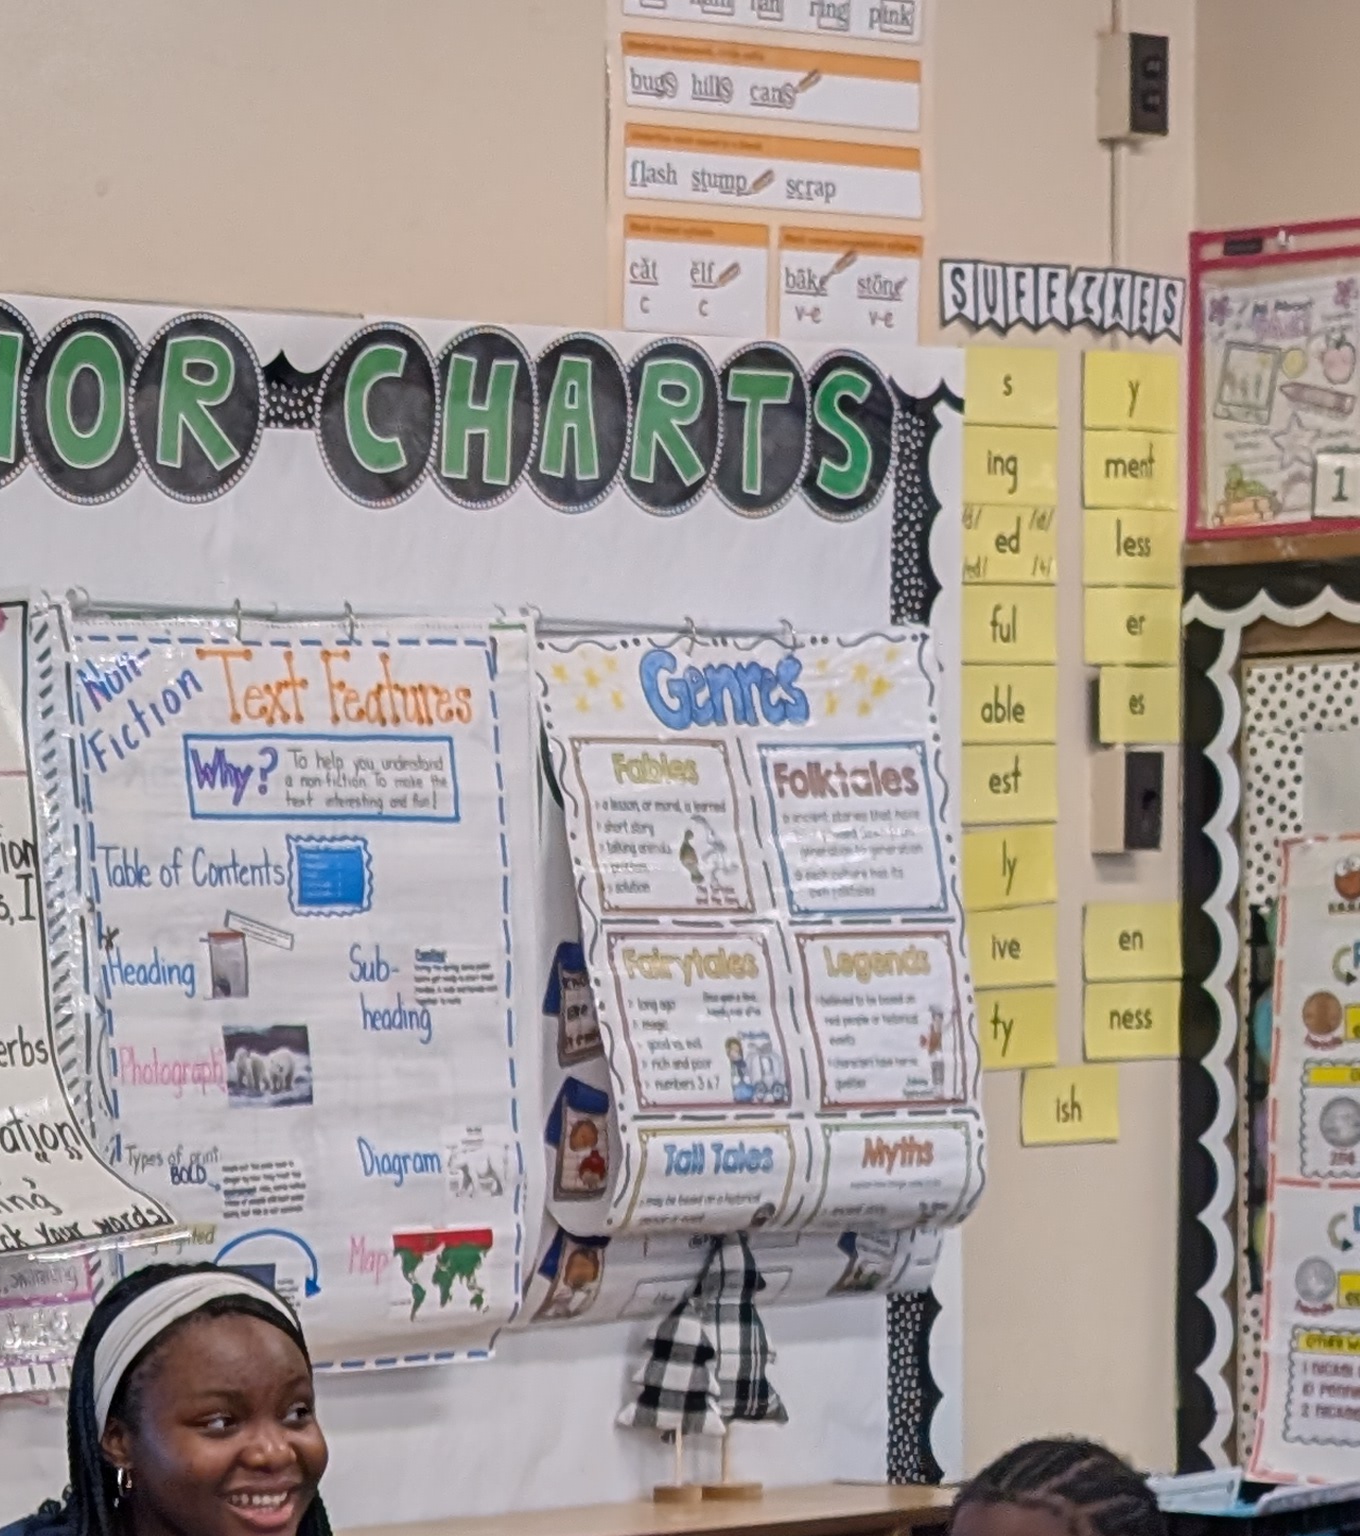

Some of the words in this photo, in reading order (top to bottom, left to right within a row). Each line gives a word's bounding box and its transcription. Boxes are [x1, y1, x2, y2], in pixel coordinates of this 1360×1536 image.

[869, 3, 912, 29] pink
[630, 69, 677, 95] bugs
[692, 74, 733, 99] hills
[750, 82, 795, 104] cans
[631, 162, 678, 185] flash
[692, 171, 748, 194] stump
[786, 177, 836, 203] scrap
[1002, 374, 1013, 397] s
[1128, 379, 1139, 417] y
[344, 344, 873, 498] CHARTS
[987, 450, 1018, 494] ing
[1105, 443, 1155, 478] ment
[1331, 466, 1349, 501] 1
[994, 516, 1021, 554] ed
[1116, 520, 1151, 557] less
[991, 604, 1017, 643] ful
[1126, 614, 1146, 636] er
[195, 648, 309, 725] Text
[320, 648, 473, 726] Features
[640, 648, 810, 730] Genres
[1128, 694, 1145, 715] es
[87, 668, 203, 774] Fiction
[981, 689, 1025, 724] able
[189, 746, 279, 807] Why?
[315, 749, 344, 775] help
[353, 757, 375, 776] you
[773, 760, 919, 799] Folktales
[988, 756, 1022, 794] est
[97, 845, 151, 889] Table
[160, 847, 183, 887] of
[191, 848, 286, 889] Contents
[1001, 839, 1018, 896] ly
[991, 935, 1022, 960] ive
[1118, 929, 1144, 951] en
[109, 947, 196, 998] Heading
[349, 943, 399, 984] Sub-
[822, 944, 931, 984] Legends
[360, 993, 433, 1044] heading
[990, 1002, 1014, 1057] ty
[1108, 1006, 1153, 1030] ness
[1055, 1085, 1082, 1123] ish
[357, 1136, 442, 1187] Diagram
[710, 1141, 774, 1175] Tales
[349, 1236, 390, 1286] Map
